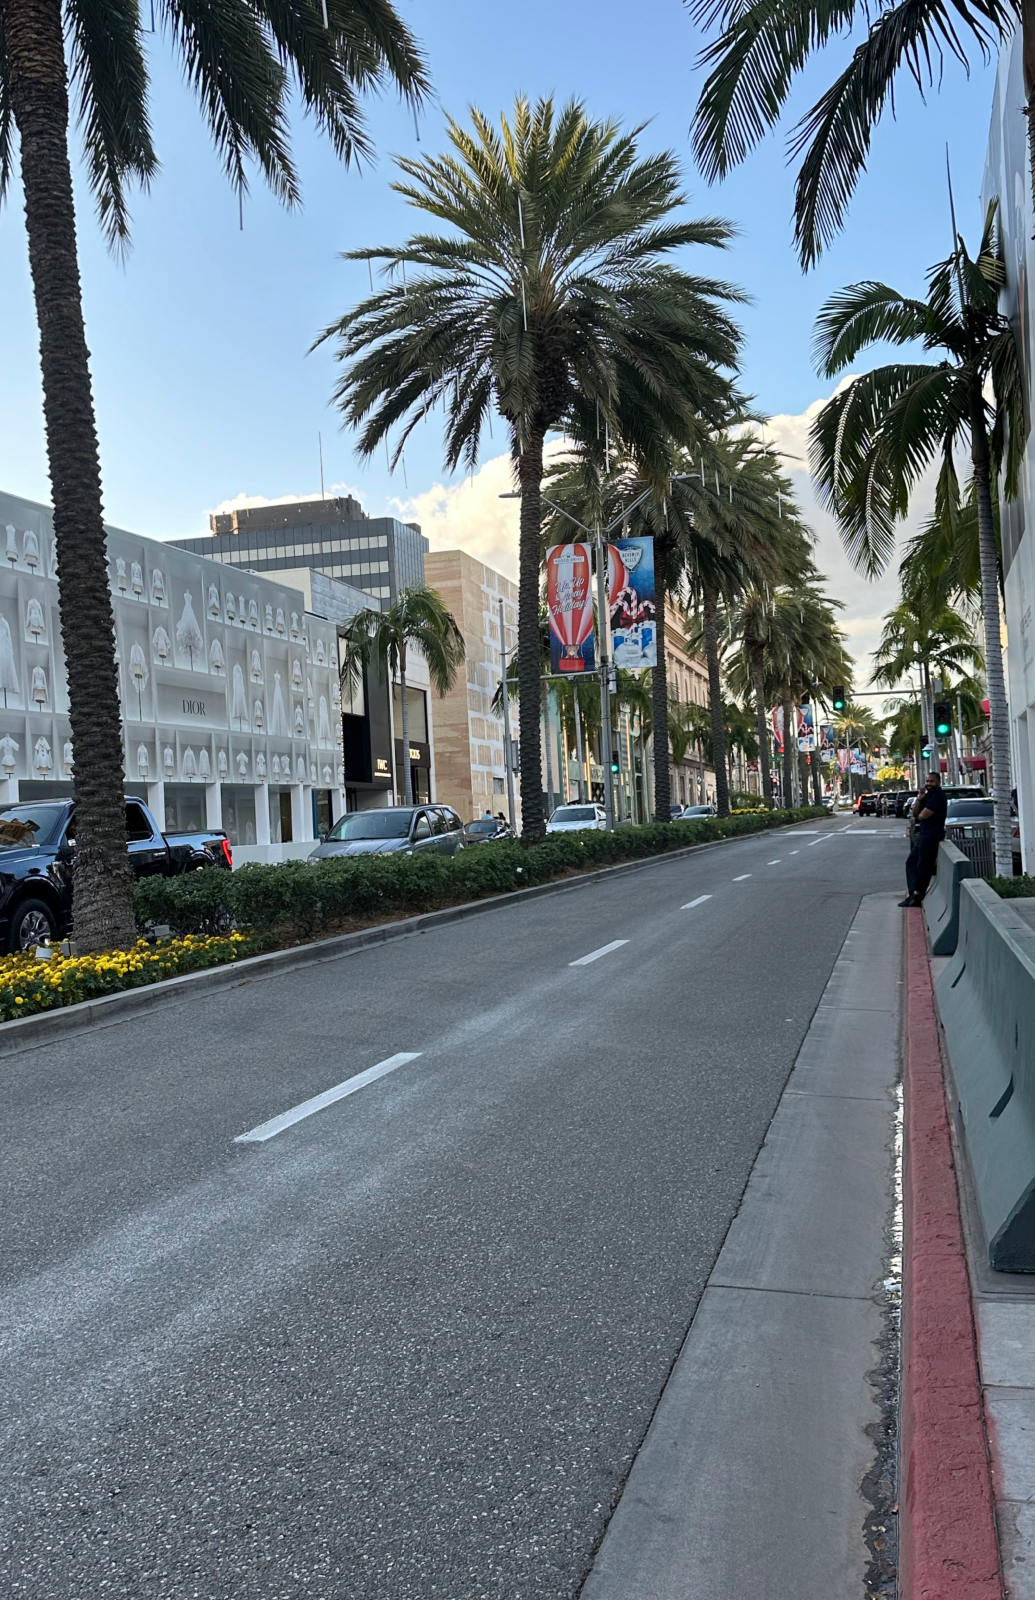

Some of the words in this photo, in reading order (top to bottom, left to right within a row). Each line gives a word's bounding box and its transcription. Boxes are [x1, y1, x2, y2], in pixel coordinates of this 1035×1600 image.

[570, 576, 584, 587] Up
[563, 589, 584, 601] Away
[183, 700, 206, 716] DIOR
[377, 758, 388, 770] IWC
